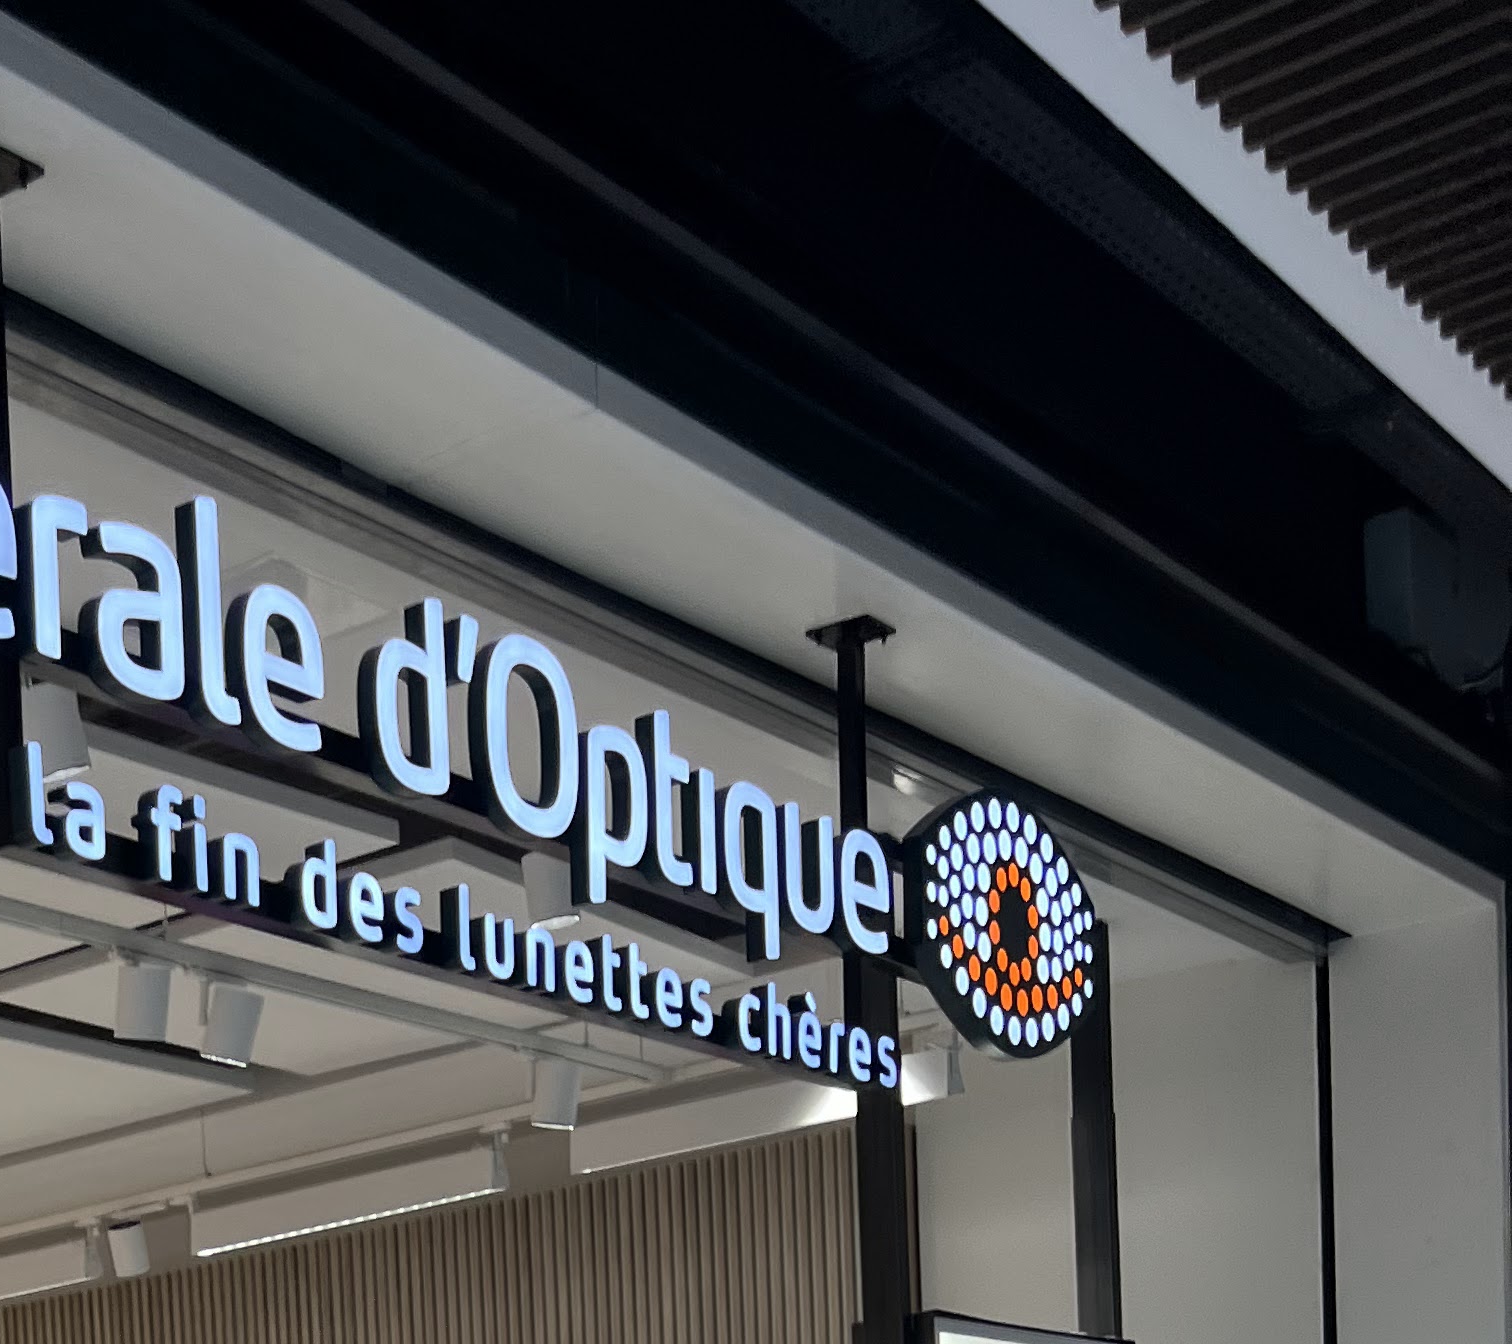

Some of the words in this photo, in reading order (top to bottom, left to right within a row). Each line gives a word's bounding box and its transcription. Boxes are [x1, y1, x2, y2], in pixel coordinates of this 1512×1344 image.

[28, 743, 106, 862] la
[152, 785, 260, 907] fin
[303, 840, 423, 955] des
[460, 880, 714, 1039] lunettes
[738, 986, 898, 1090] chères
[372, 597, 890, 958] d'Optique
